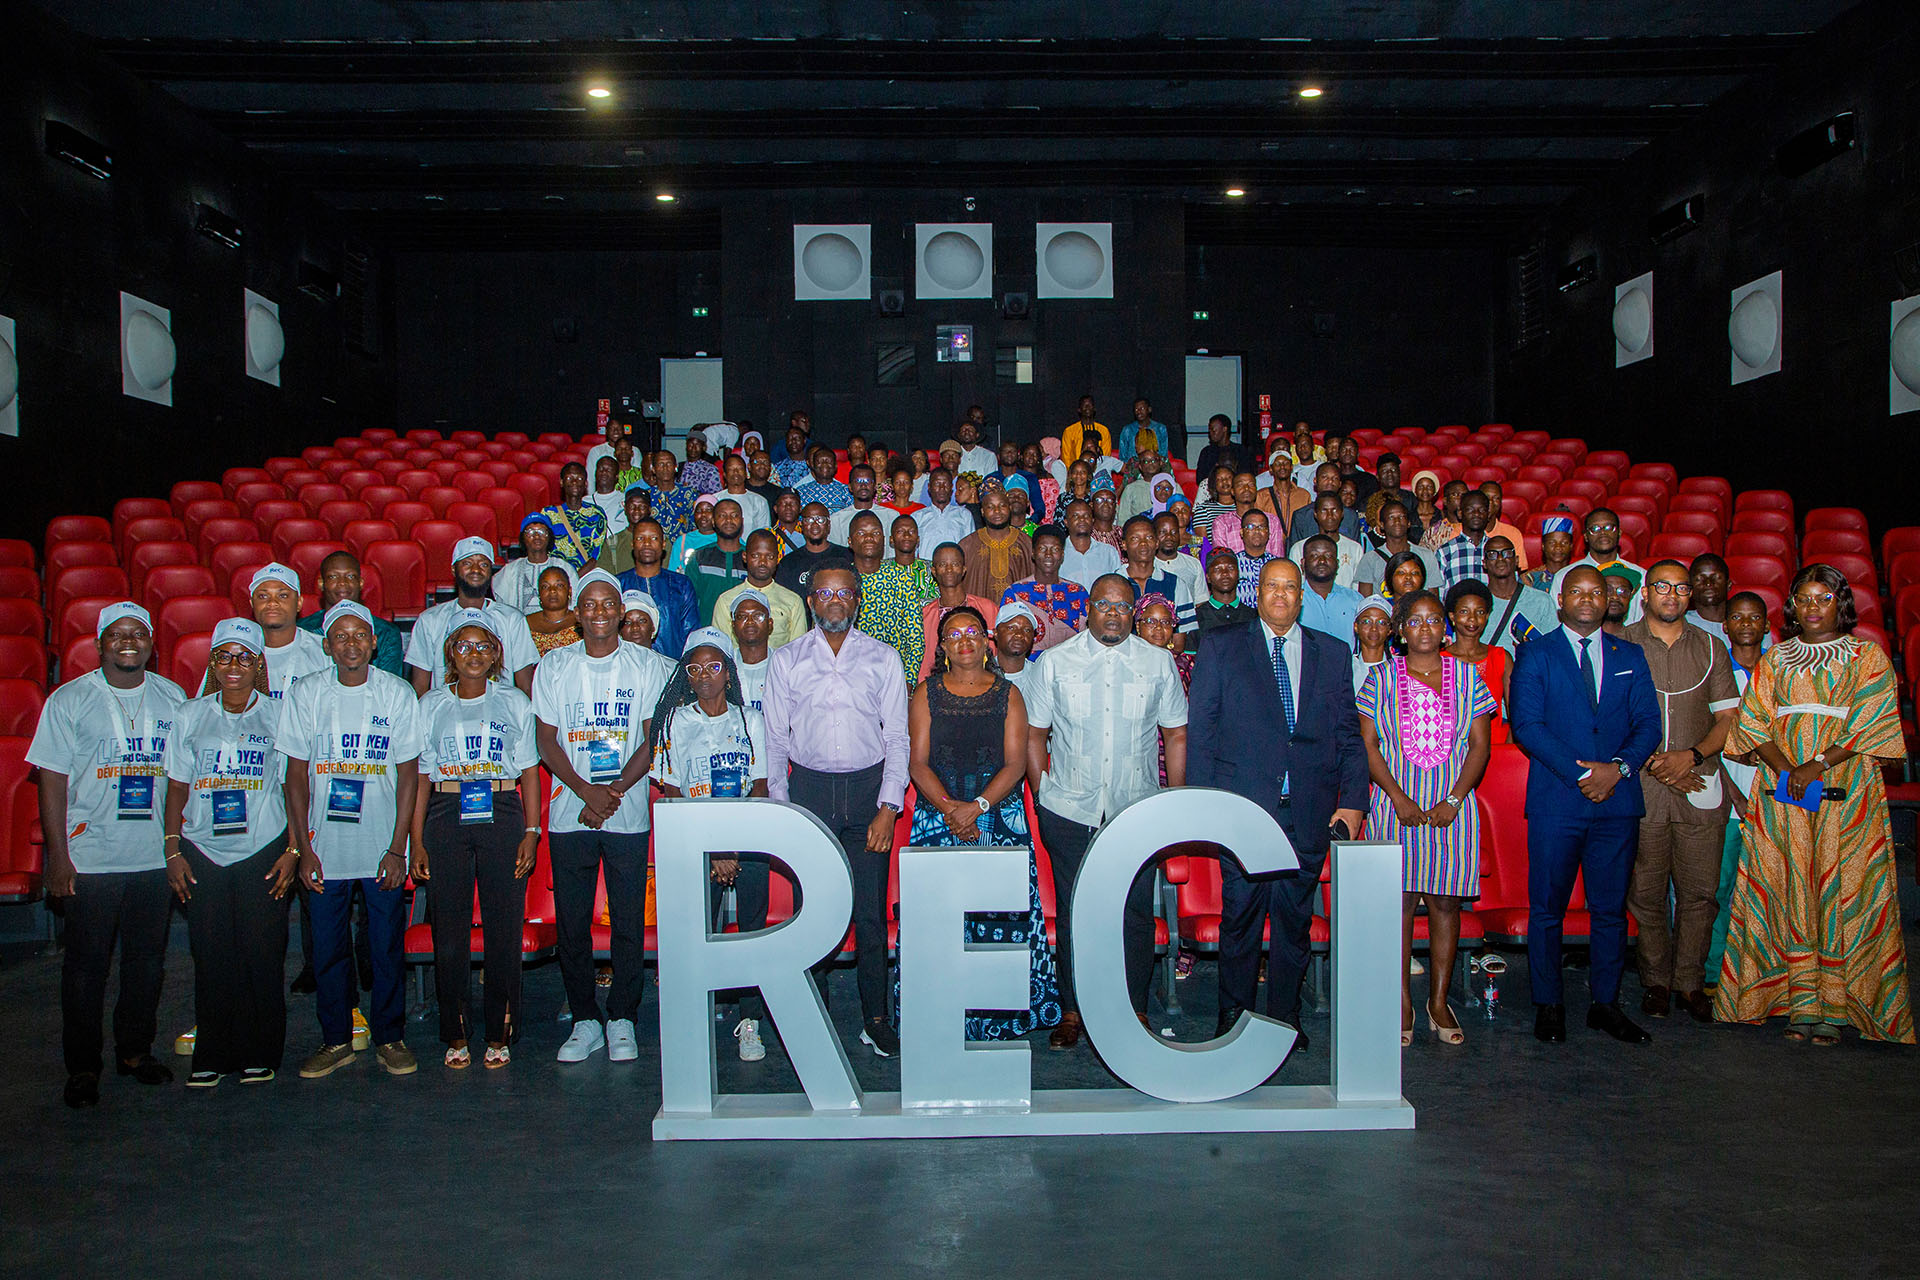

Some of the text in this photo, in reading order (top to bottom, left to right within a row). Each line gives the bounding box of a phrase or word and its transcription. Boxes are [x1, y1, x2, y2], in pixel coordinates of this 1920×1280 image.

[342, 733, 390, 750] CITYEN
[687, 756, 710, 783] LE
[654, 788, 1402, 1113] RECI
